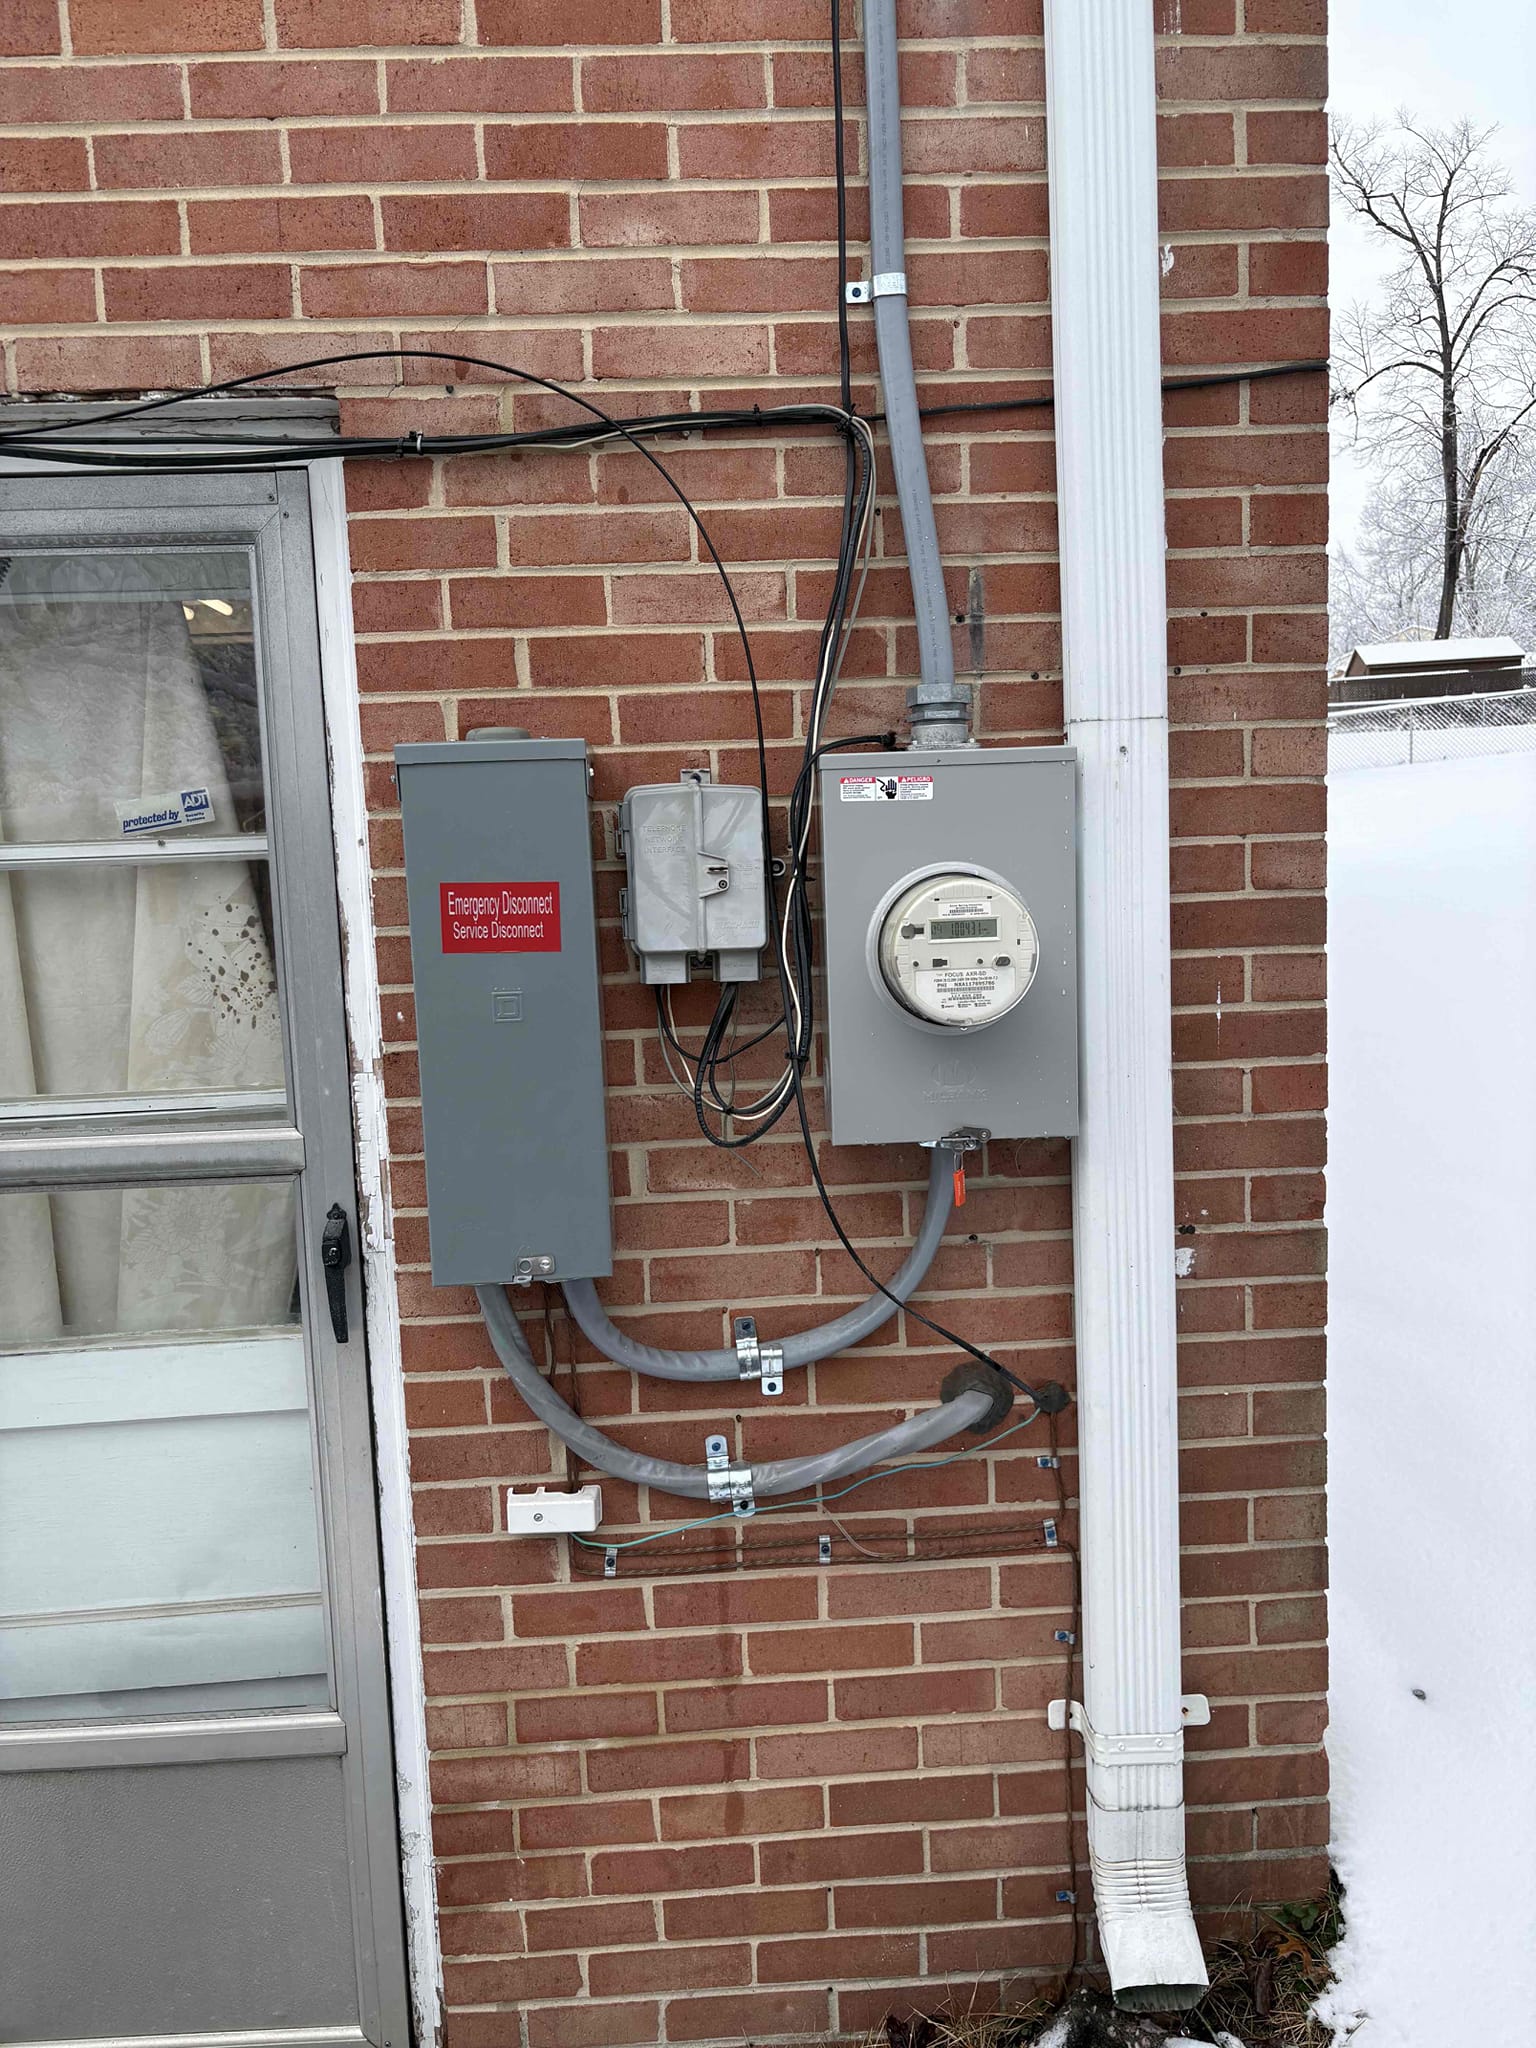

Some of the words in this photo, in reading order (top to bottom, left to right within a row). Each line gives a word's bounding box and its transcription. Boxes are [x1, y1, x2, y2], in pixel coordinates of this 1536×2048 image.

[183, 793, 207, 809] ADT
[123, 811, 167, 830] protected
[168, 809, 180, 821] by
[447, 891, 500, 921] Emergency
[502, 890, 553, 915] Disconnect
[453, 921, 489, 939] Service
[491, 921, 544, 938] Disconnect
